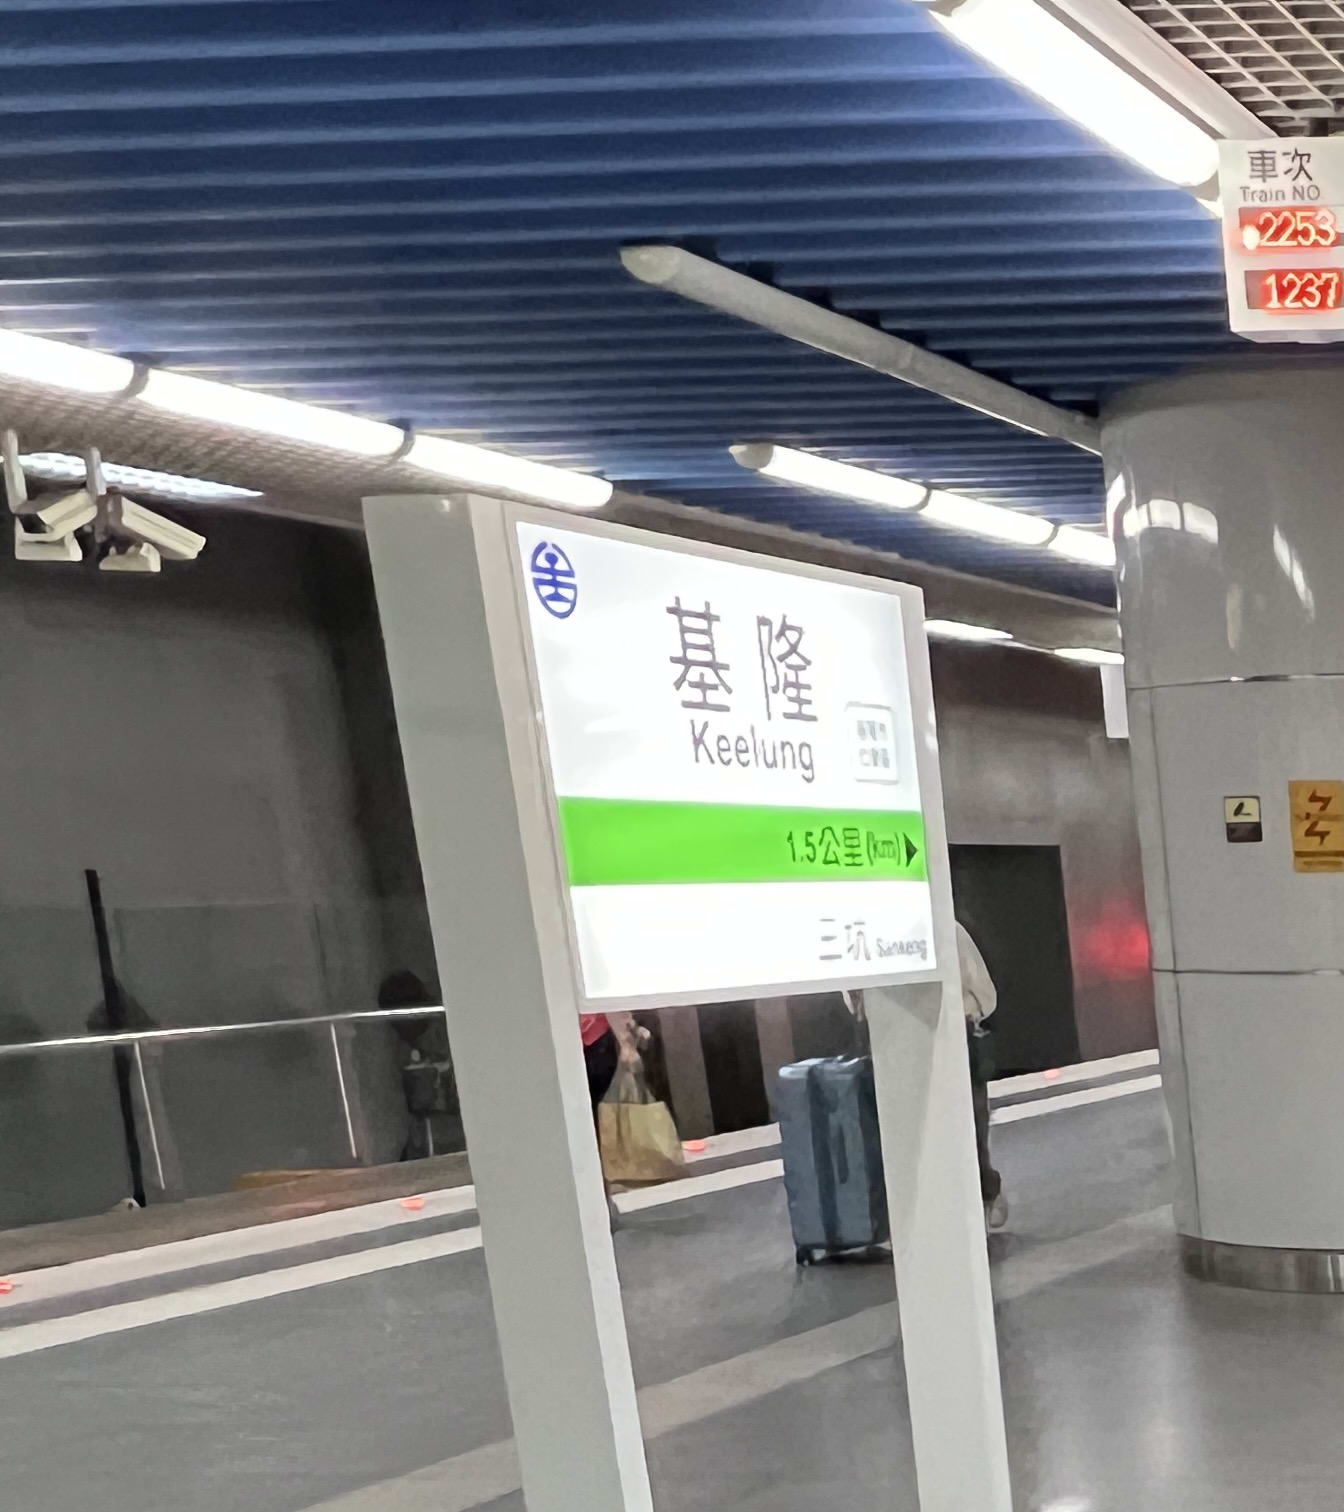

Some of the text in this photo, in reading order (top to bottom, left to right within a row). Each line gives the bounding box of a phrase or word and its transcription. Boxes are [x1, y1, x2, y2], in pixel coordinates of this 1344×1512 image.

[1247, 147, 1313, 182] 車次
[1239, 186, 1286, 202] Train
[1258, 209, 1336, 246] 2253
[1266, 272, 1339, 309] 1237
[666, 596, 818, 721] 基隆
[689, 719, 815, 783] Keelung
